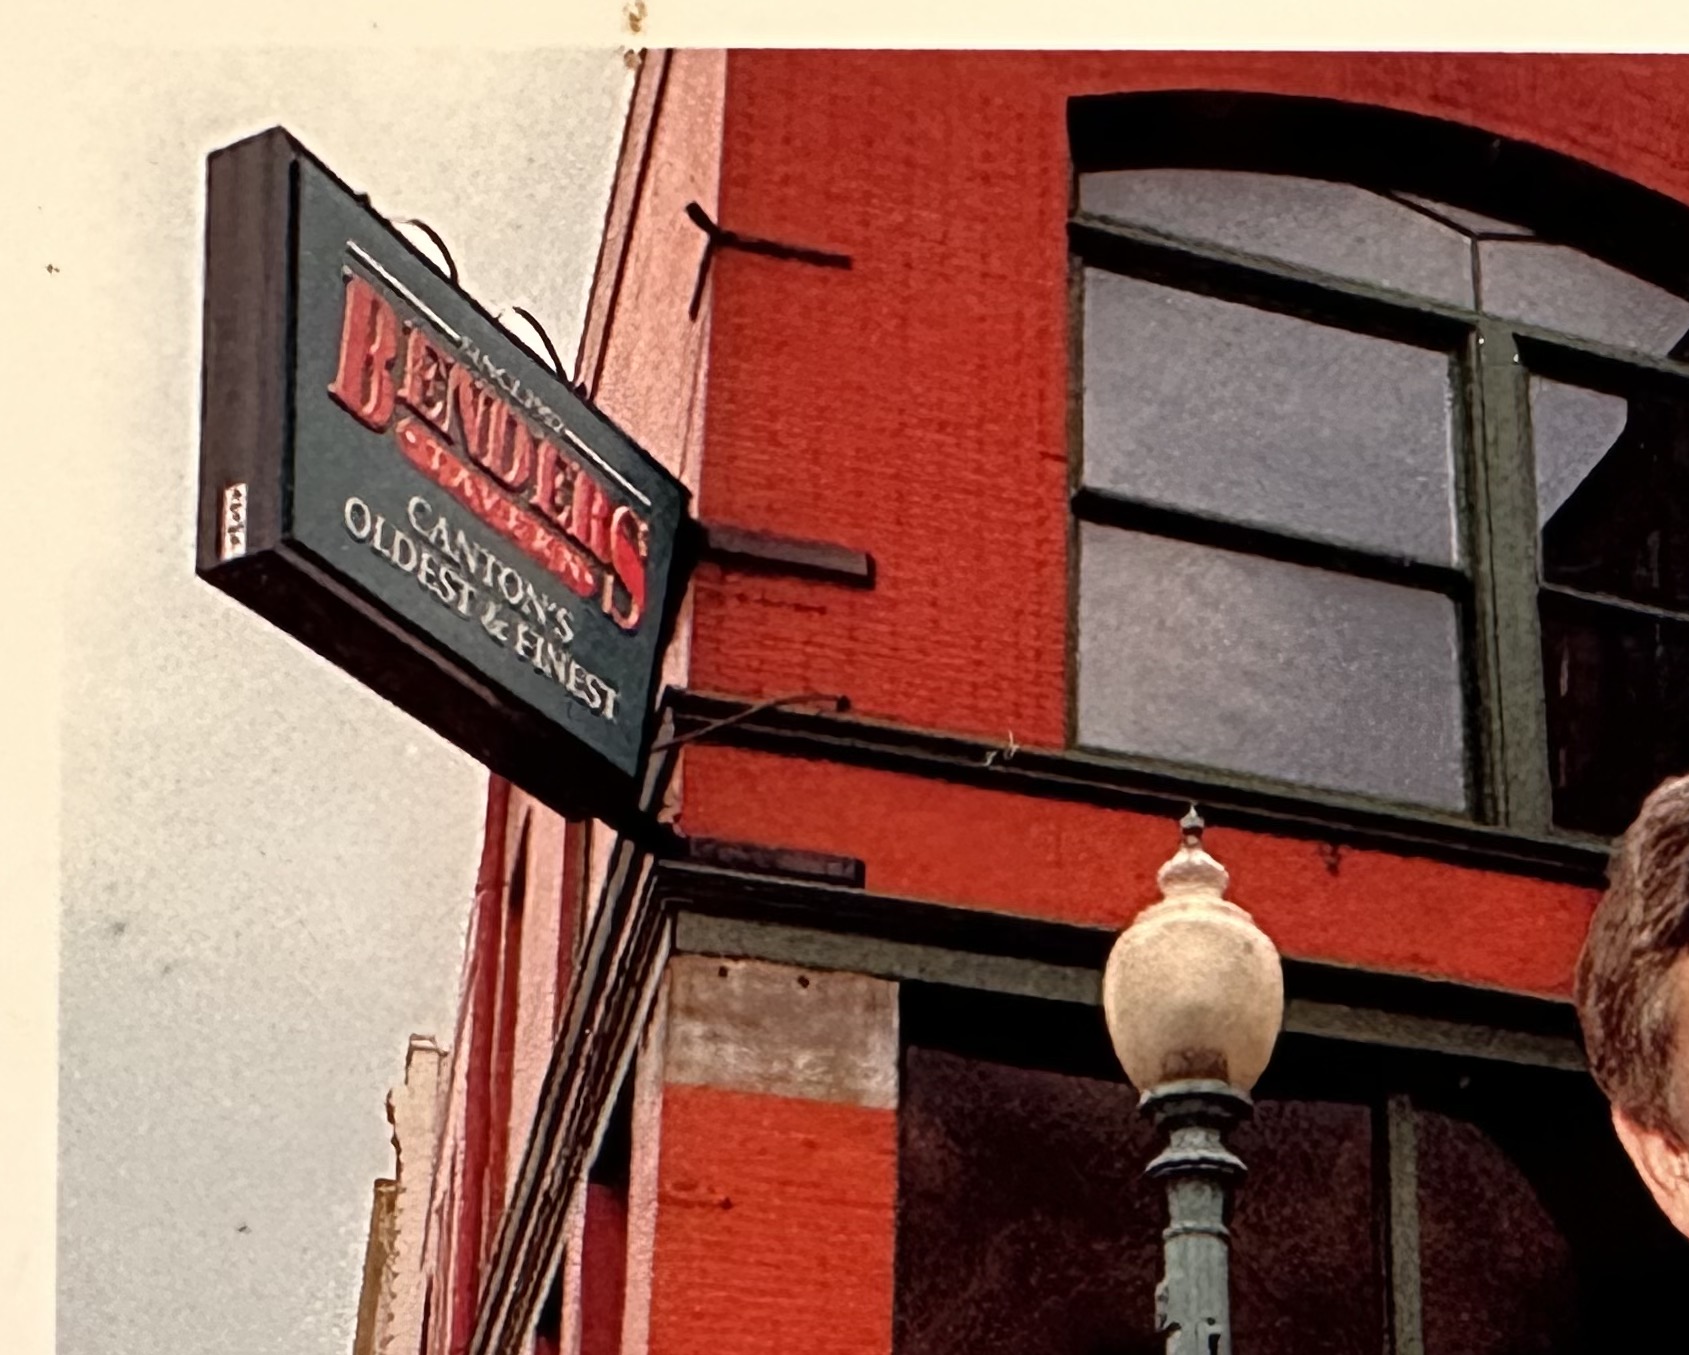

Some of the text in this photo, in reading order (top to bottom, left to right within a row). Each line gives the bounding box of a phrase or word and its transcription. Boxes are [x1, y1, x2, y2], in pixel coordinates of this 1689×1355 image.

[344, 496, 476, 616] OLDEST
[516, 622, 620, 721] FINEST
[407, 496, 574, 643] CANTON'S
